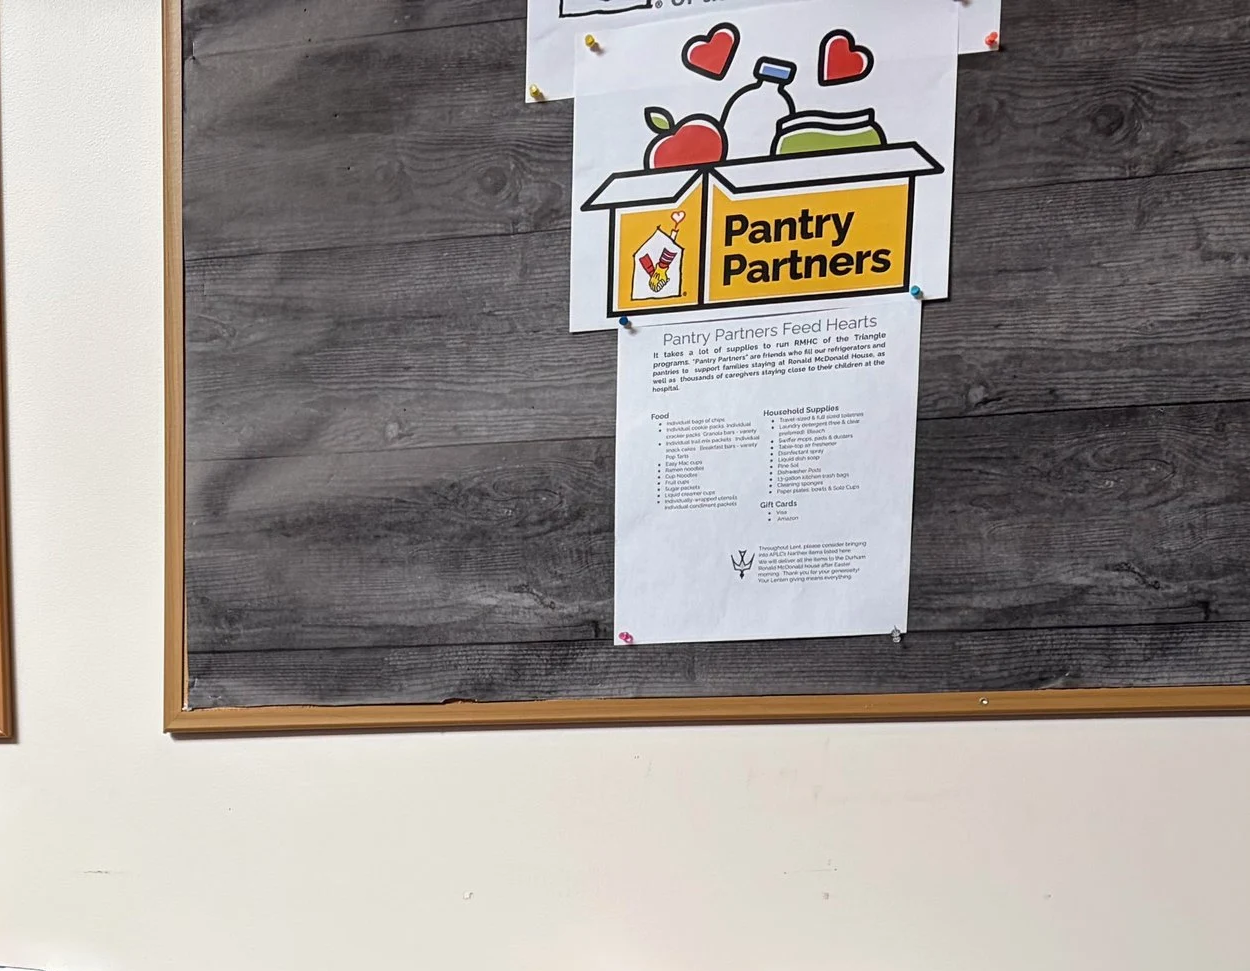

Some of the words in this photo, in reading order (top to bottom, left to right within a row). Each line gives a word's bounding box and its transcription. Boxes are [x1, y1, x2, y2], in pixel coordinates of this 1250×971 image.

[724, 209, 854, 249] Pantry
[723, 247, 892, 286] Partners
[663, 332, 711, 346] Pantry
[715, 325, 778, 342] Partners
[783, 320, 821, 335] Feed
[826, 316, 877, 331] Hearts
[664, 350, 684, 358] takes
[726, 344, 758, 353] supplies
[794, 338, 818, 347] RMHC
[854, 332, 886, 341] Triangle
[763, 408, 804, 417] Household
[806, 404, 839, 414] Supplies
[760, 501, 774, 509] Gift
[775, 500, 797, 508] Cards
